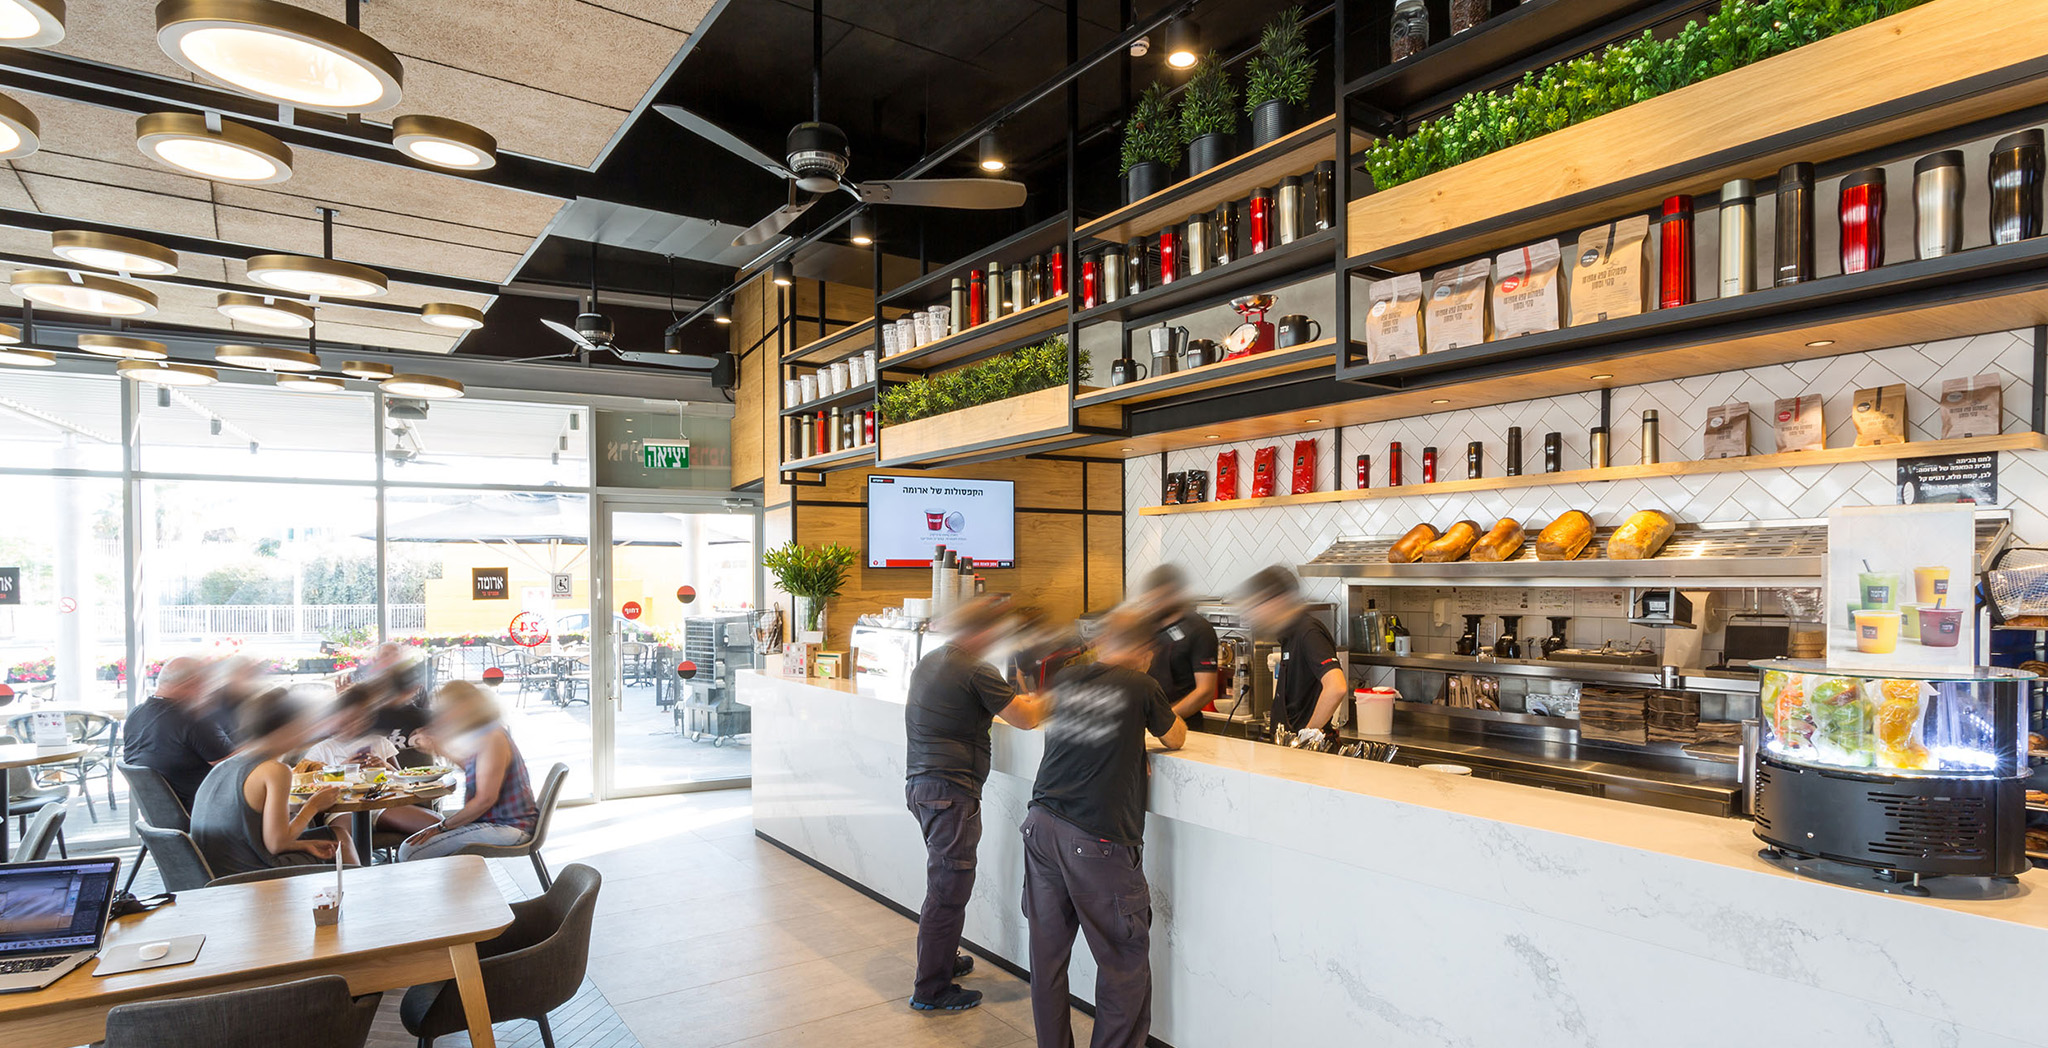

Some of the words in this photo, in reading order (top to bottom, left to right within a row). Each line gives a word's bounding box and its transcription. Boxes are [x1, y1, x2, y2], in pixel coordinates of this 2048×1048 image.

[648, 446, 686, 468] יציאה
[902, 486, 928, 494] ארומה
[930, 486, 942, 494] של
[944, 486, 984, 496] הקפסולות
[477, 577, 503, 590] ארומה
